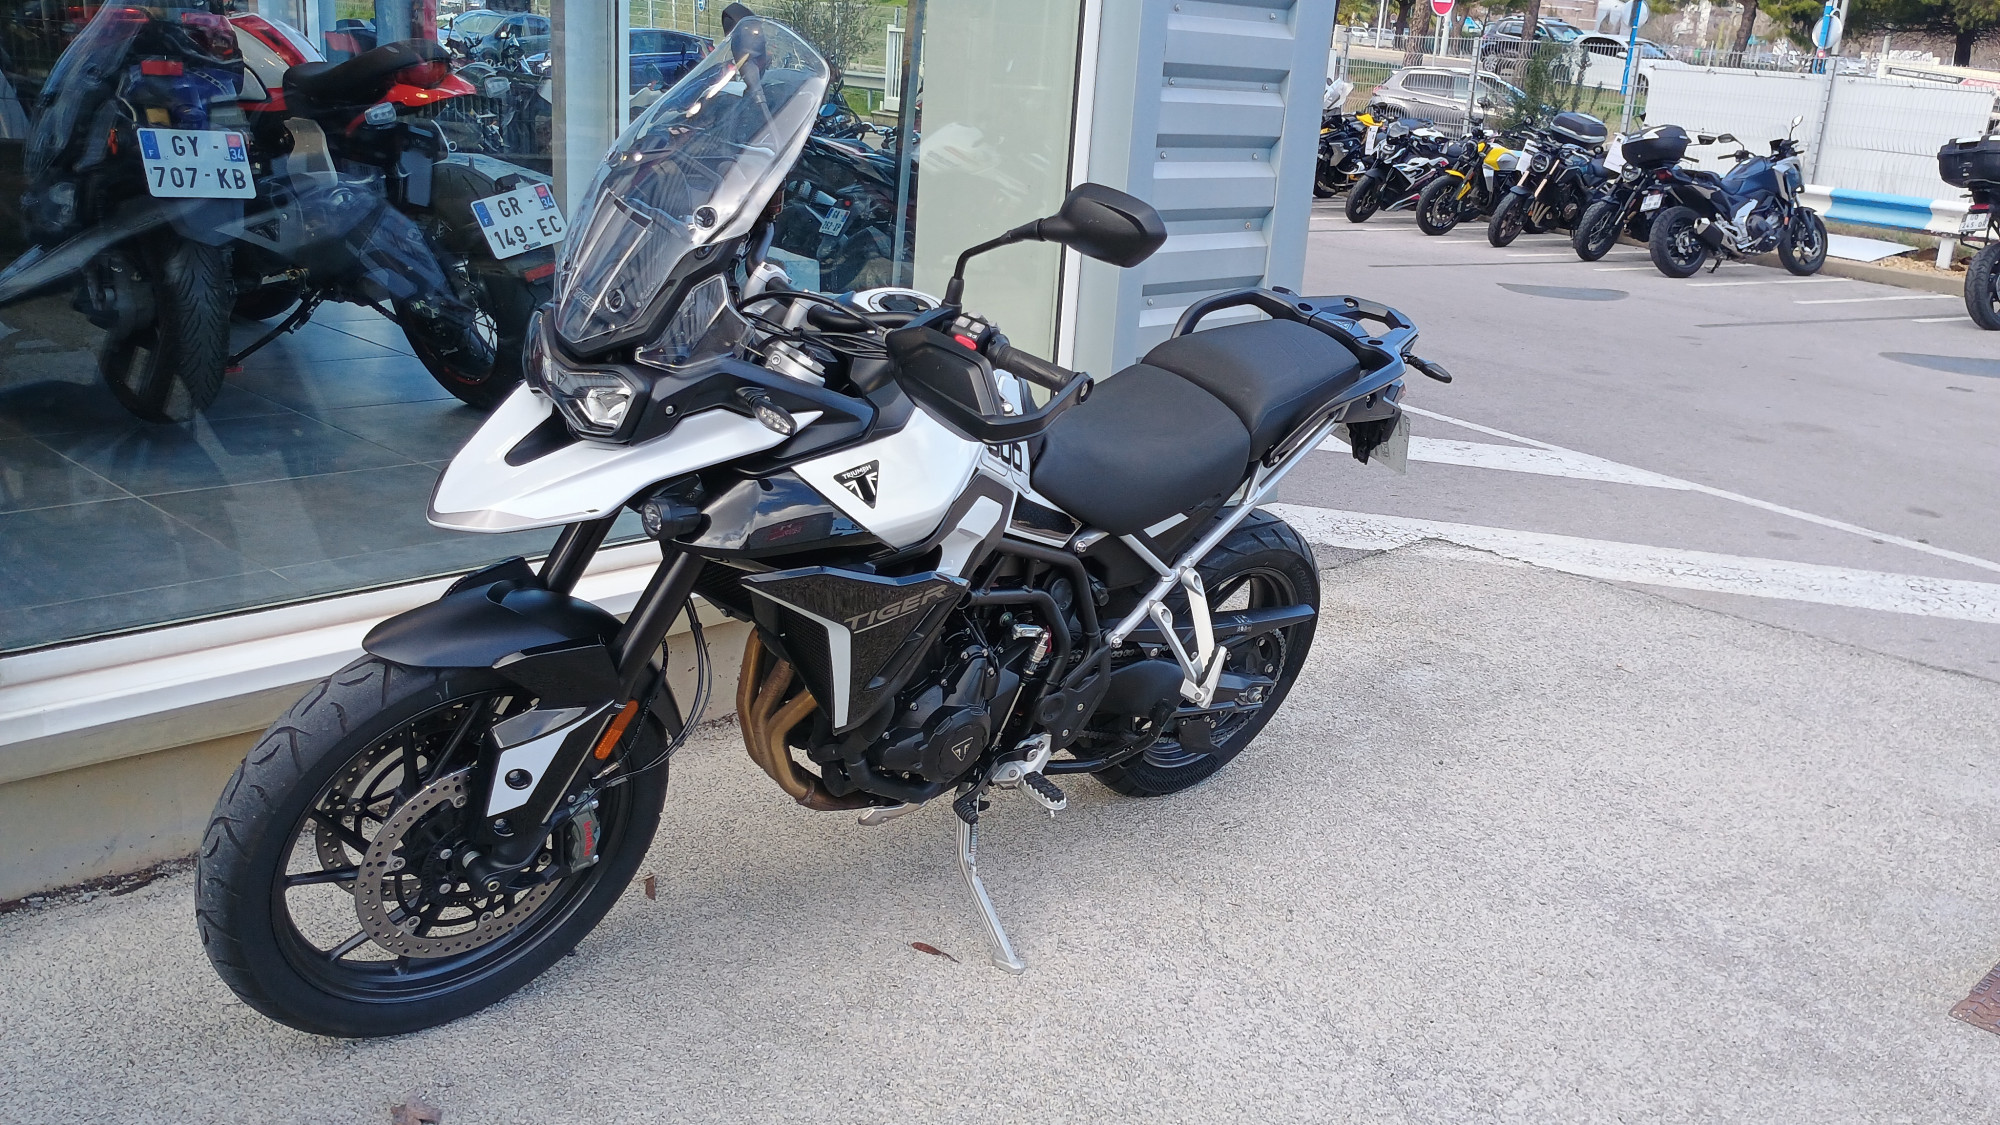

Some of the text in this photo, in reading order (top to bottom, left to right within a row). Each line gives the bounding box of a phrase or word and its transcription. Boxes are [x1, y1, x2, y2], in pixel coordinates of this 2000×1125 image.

[148, 149, 154, 157] F
[171, 135, 199, 157] GY
[229, 148, 244, 160] 34
[152, 166, 247, 190] 707-KB
[497, 196, 523, 218] GR
[541, 196, 553, 209] 34
[493, 215, 562, 250] 149-EC
[842, 465, 872, 479] TRIUMPH
[843, 584, 948, 630] TIGER
